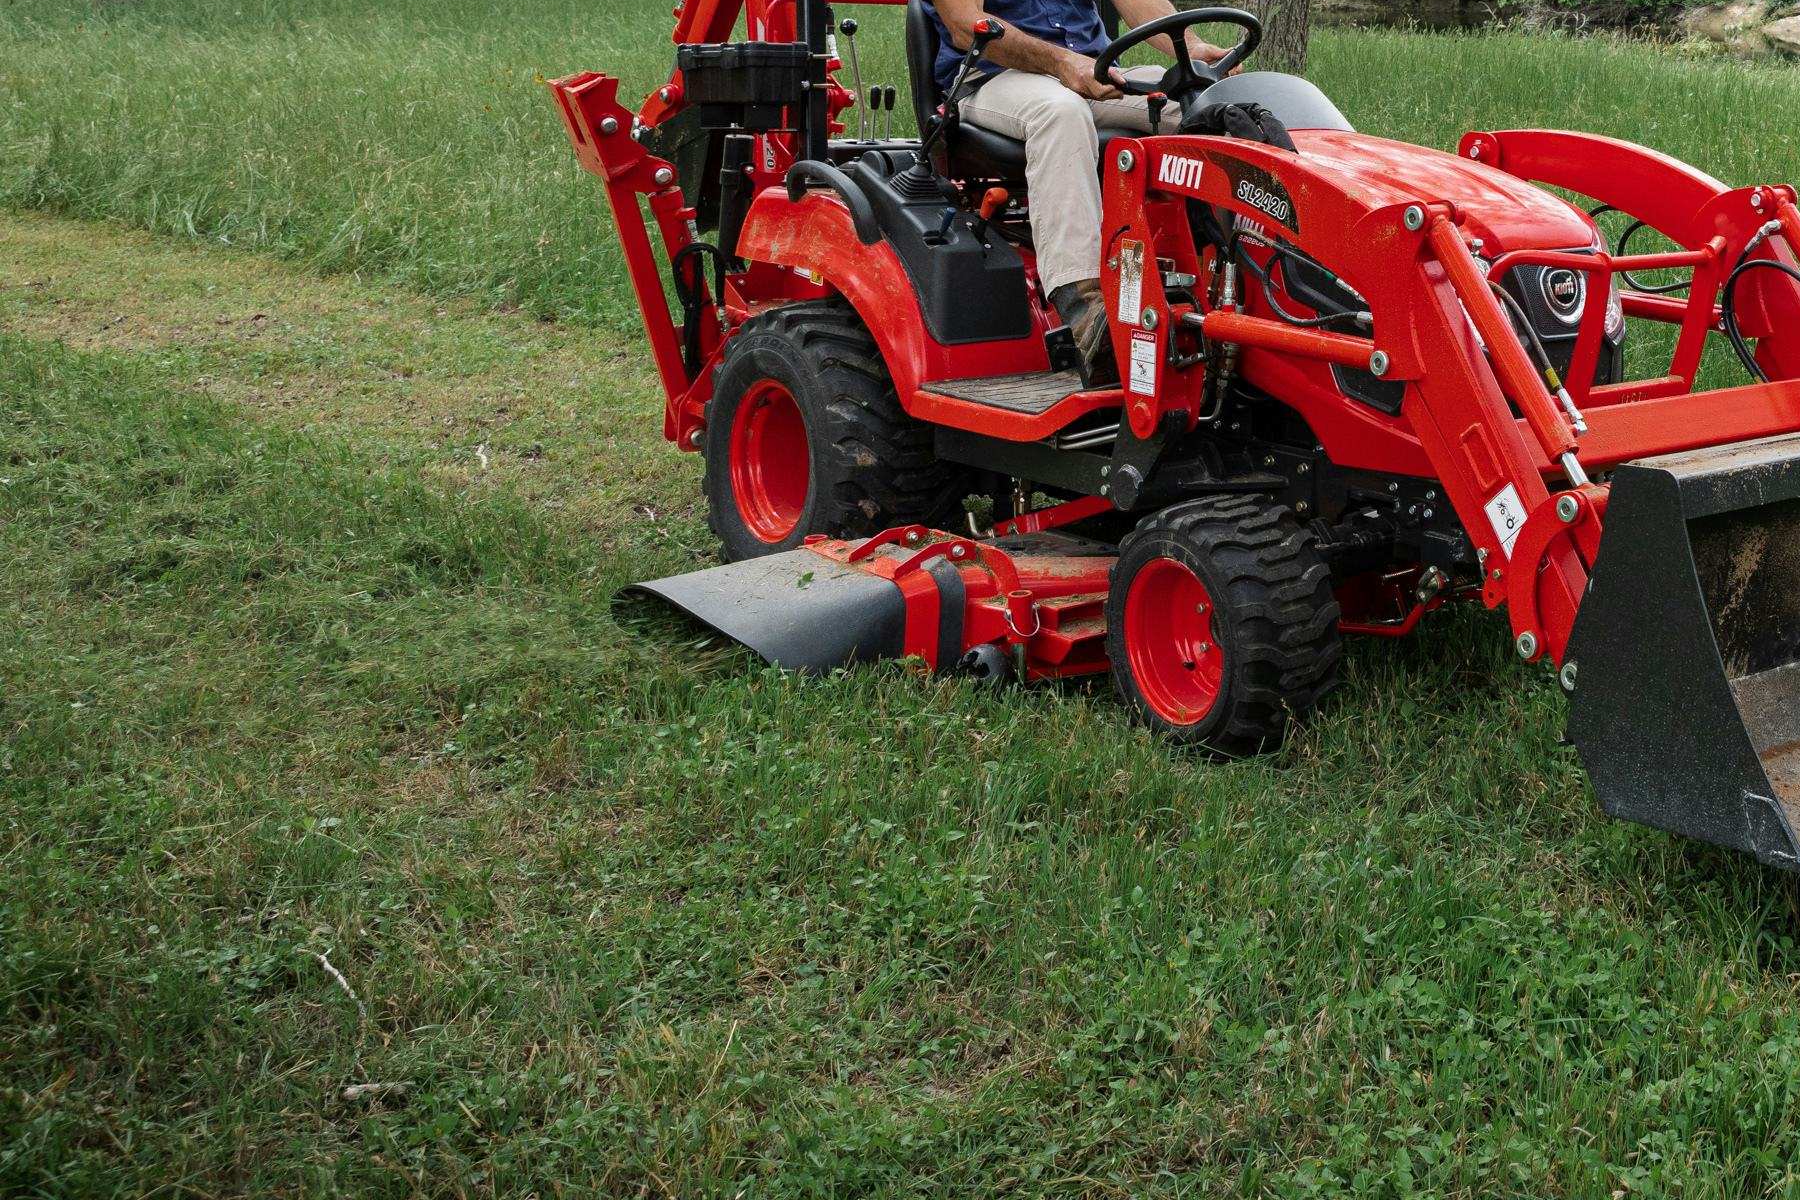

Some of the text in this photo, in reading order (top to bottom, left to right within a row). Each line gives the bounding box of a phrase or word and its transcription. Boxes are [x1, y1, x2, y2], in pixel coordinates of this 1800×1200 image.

[1158, 153, 1203, 189] KIOTI
[1237, 179, 1288, 220] SL2420
[1554, 278, 1574, 296] KIOTI
